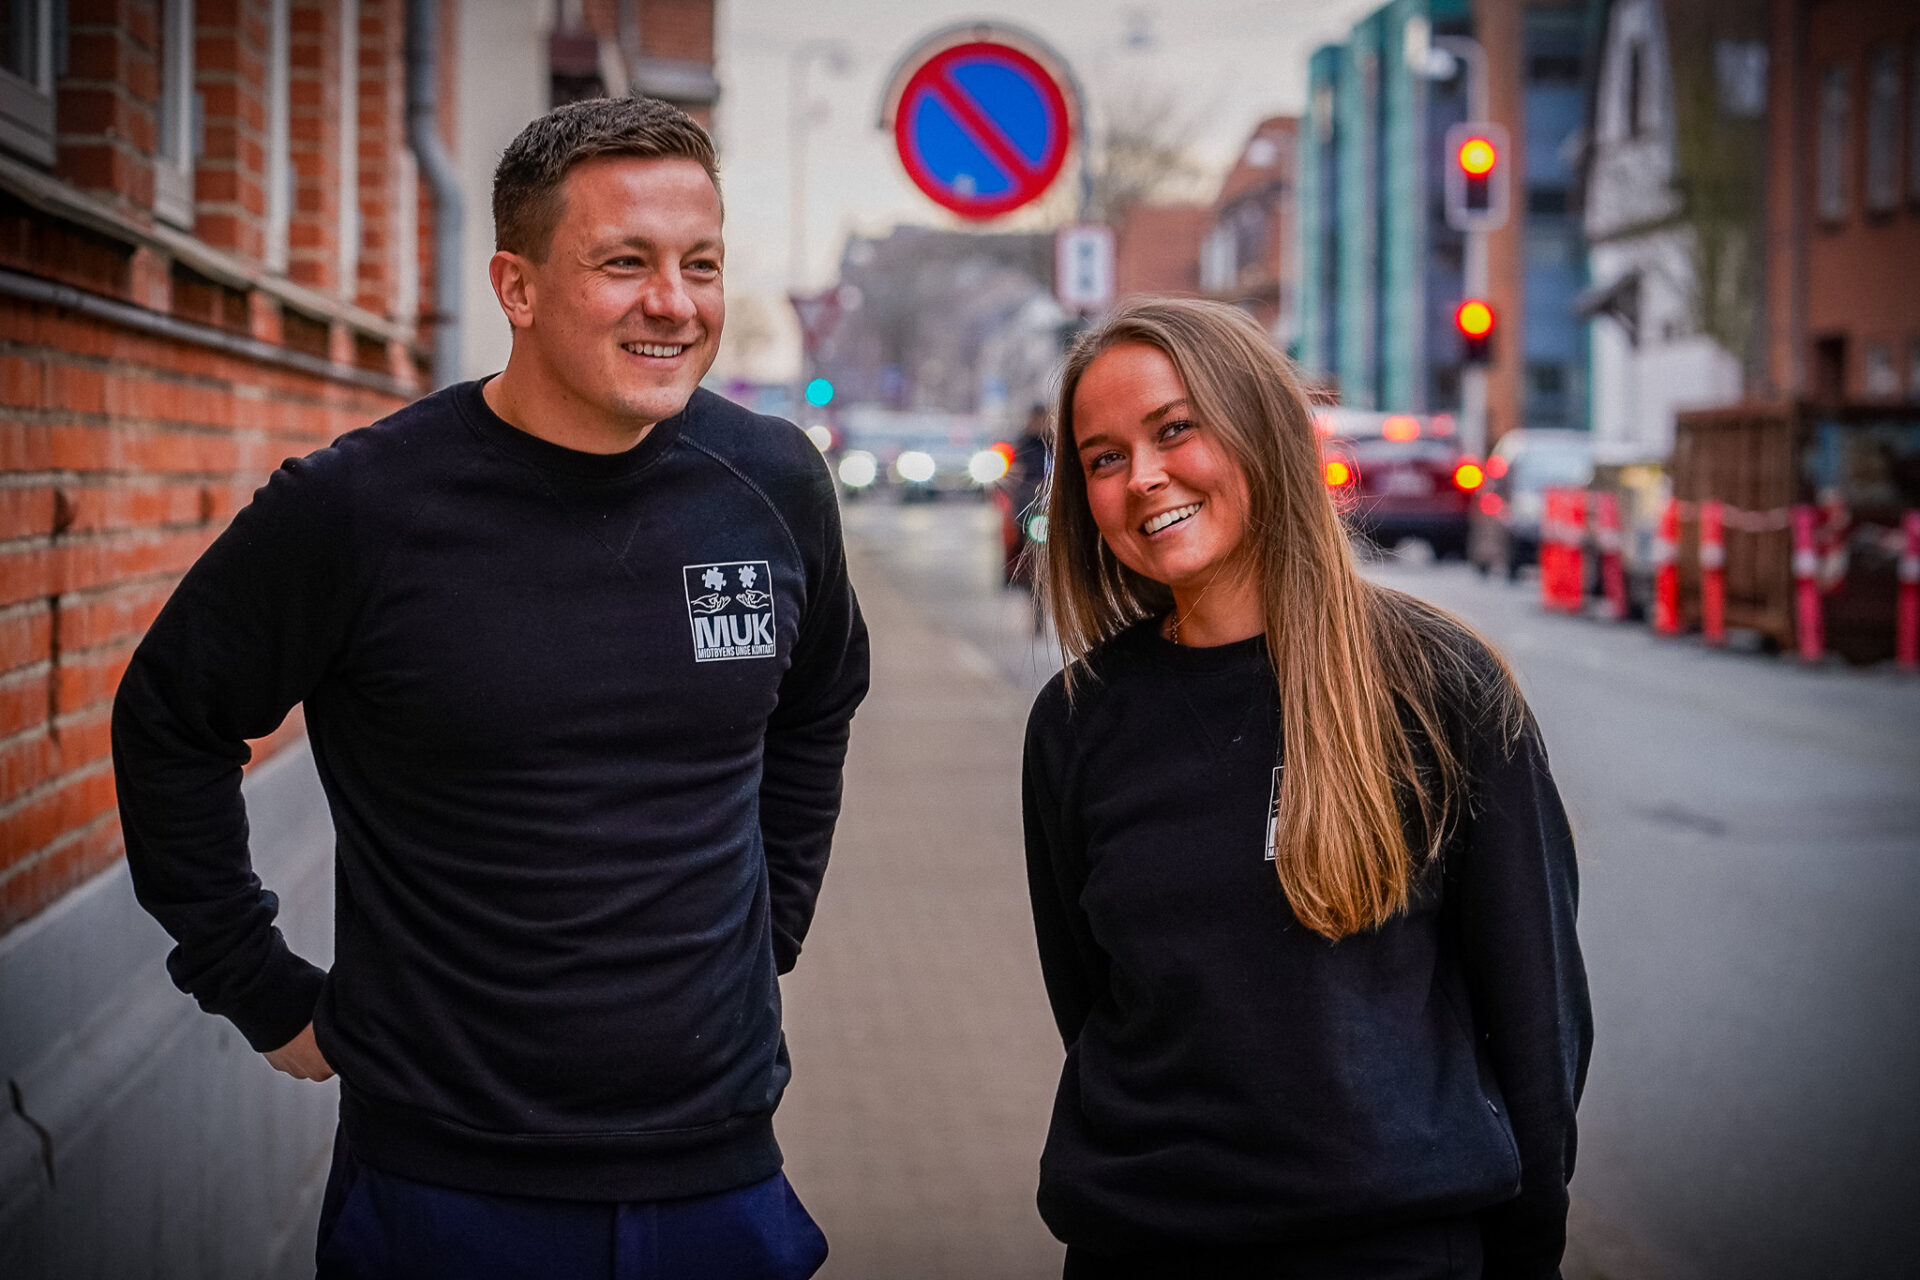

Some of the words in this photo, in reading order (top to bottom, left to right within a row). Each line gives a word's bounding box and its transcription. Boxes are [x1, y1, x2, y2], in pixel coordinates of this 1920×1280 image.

[694, 613, 773, 648] MUK
[698, 646, 735, 658] MIDTBYENS
[735, 645, 751, 656] UNGE
[751, 644, 774, 654] KONTAKT
